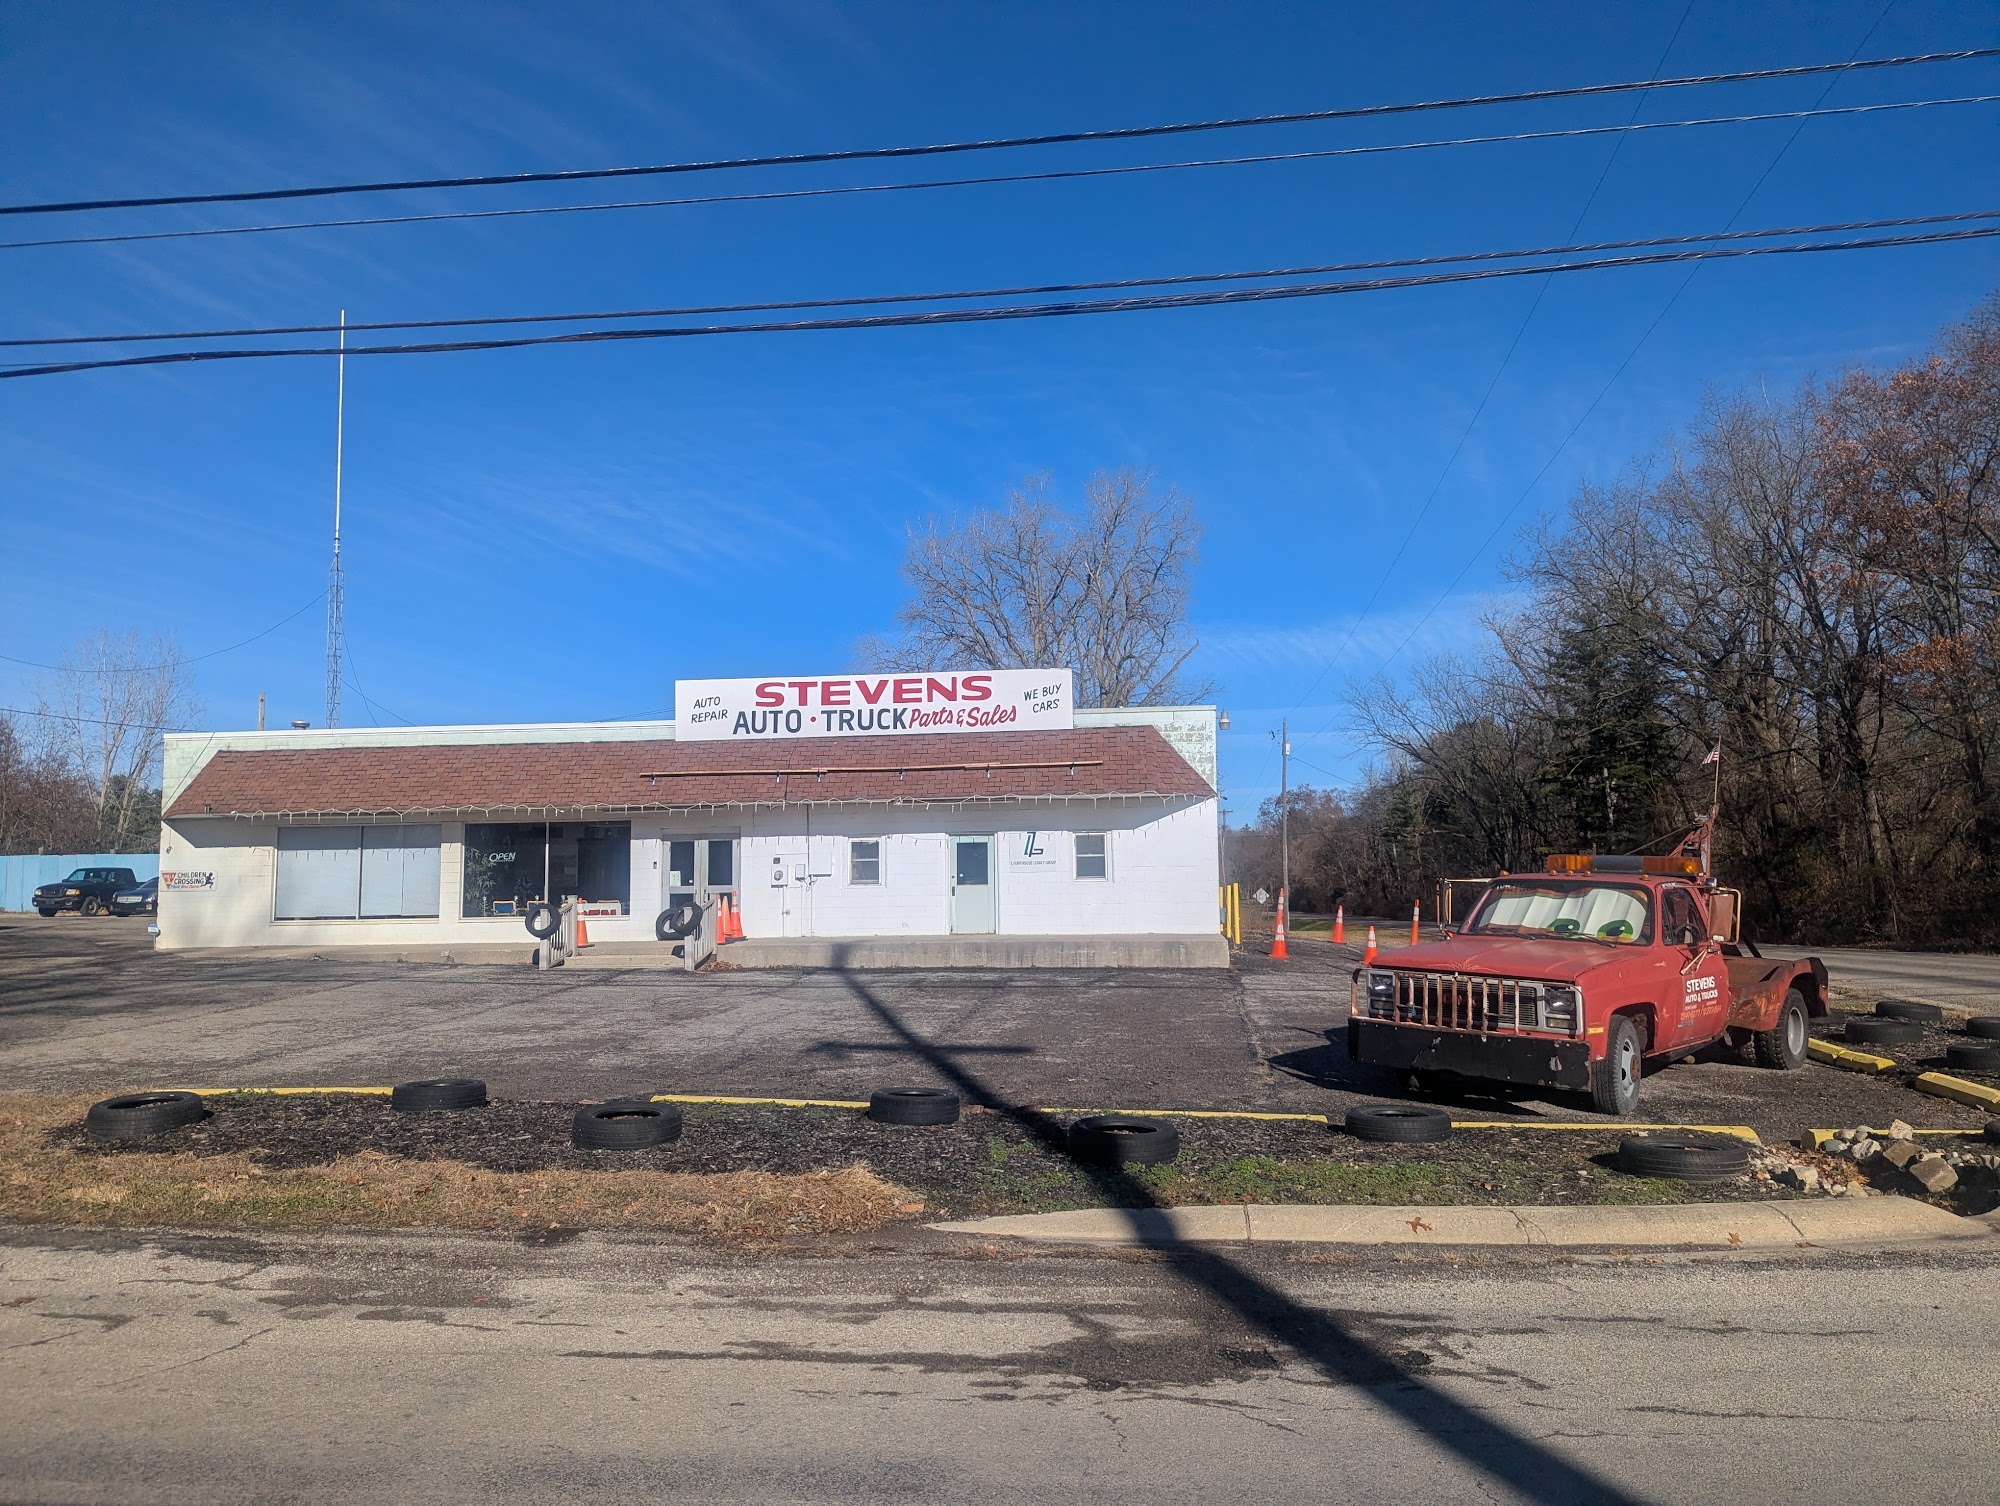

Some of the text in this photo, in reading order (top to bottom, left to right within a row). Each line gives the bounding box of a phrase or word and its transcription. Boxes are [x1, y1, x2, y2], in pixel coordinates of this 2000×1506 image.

[755, 675, 993, 707] STEVENS
[1023, 683, 1062, 702] WE BUY
[693, 696, 721, 709] AUTO
[1032, 698, 1060, 714] CARS
[691, 709, 728, 724] REPAIR
[732, 704, 1017, 735] AUTO TRUCK Parts & Sales
[489, 852, 516, 862] OPEN
[1686, 976, 1715, 992] STEVENS
[1685, 993, 1697, 1003] AUTO
[1701, 989, 1718, 1000] TRUCKS
